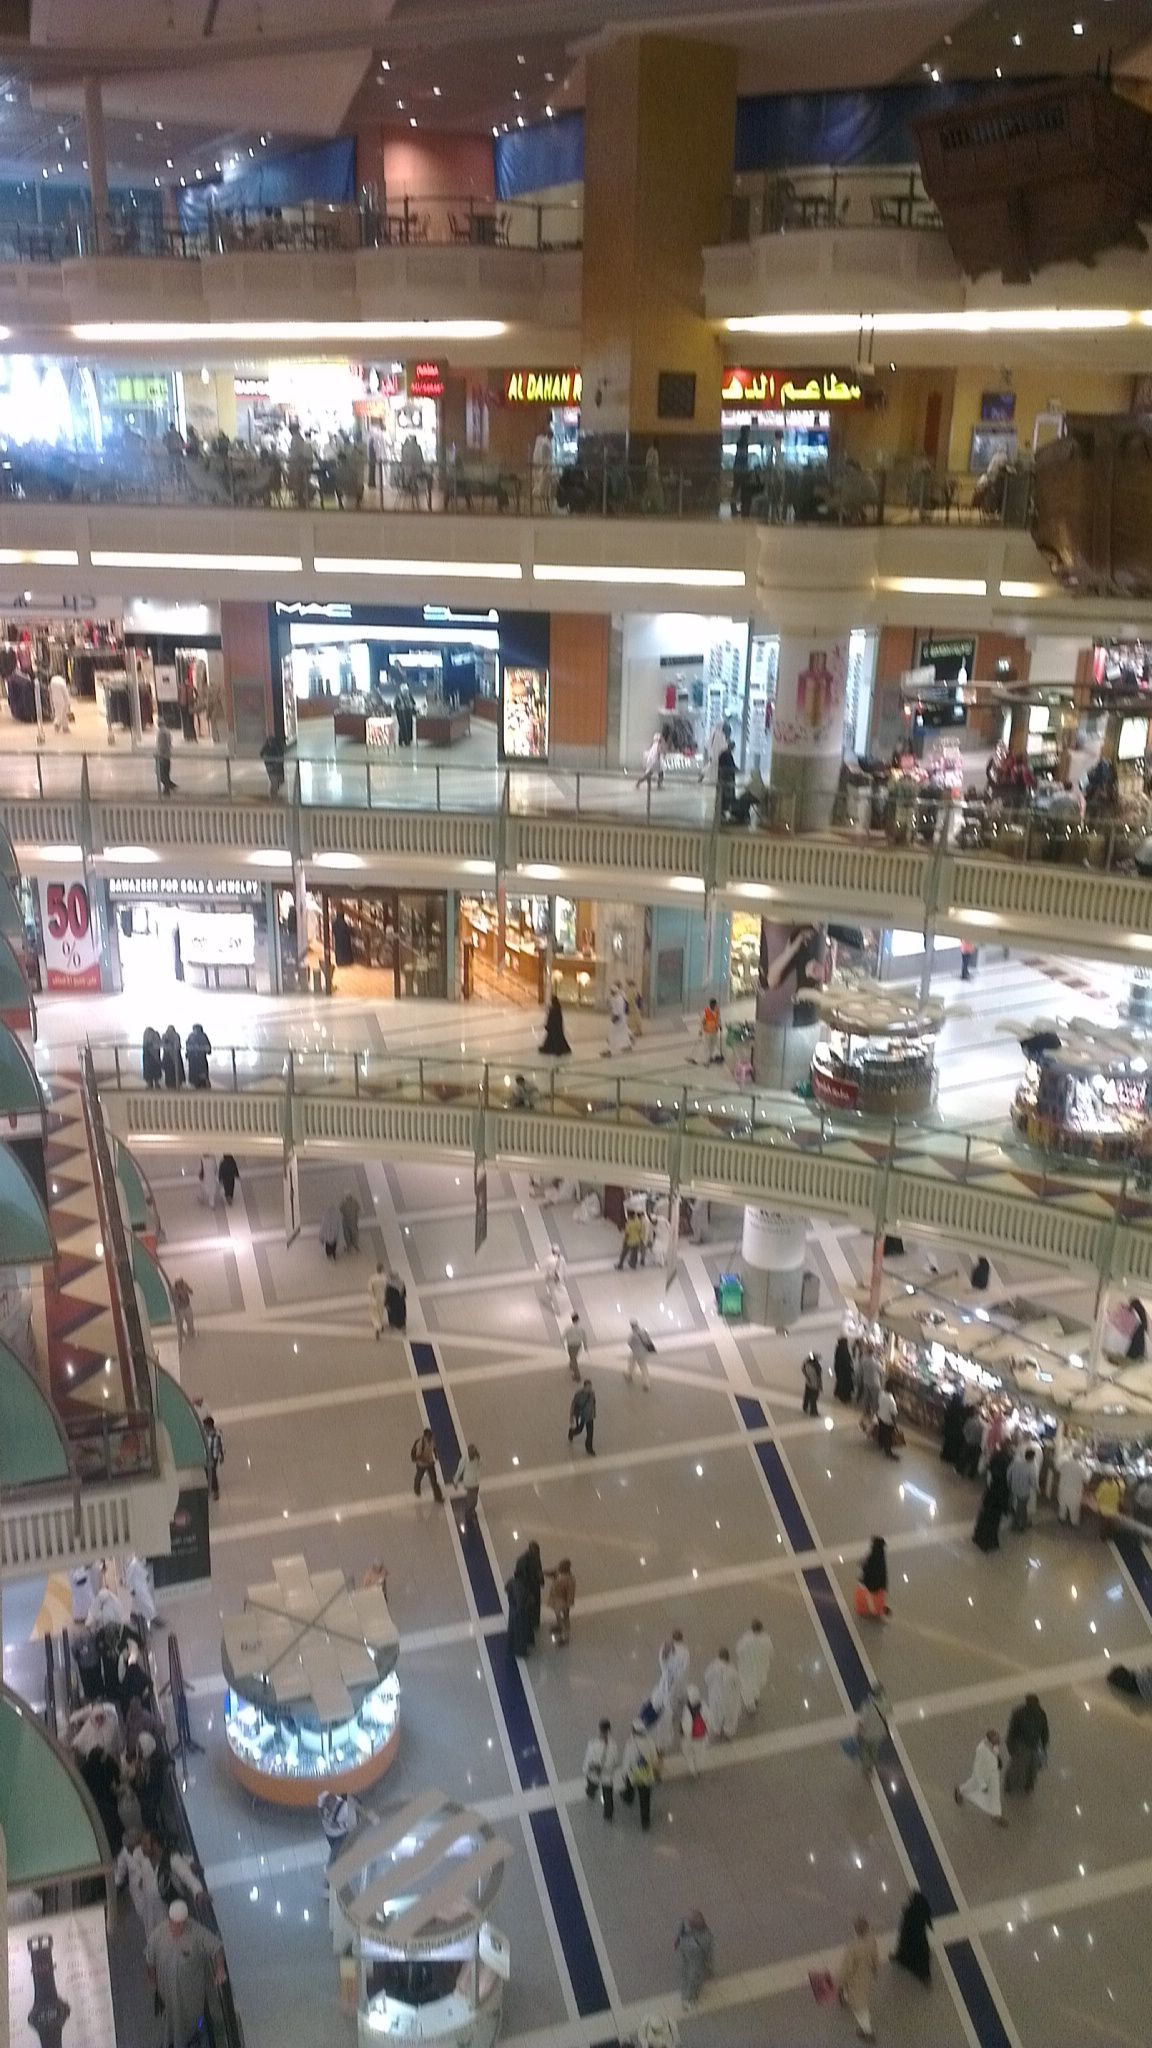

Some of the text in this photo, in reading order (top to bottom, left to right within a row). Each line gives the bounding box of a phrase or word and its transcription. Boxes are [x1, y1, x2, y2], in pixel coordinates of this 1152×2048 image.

[508, 373, 523, 401] AL
[526, 373, 571, 401] DAHAN
[160, 879, 179, 893] FOR
[180, 879, 205, 894] GOLD
[206, 879, 214, 894] &
[215, 879, 259, 895] JEWELRY
[47, 884, 90, 939] 50
